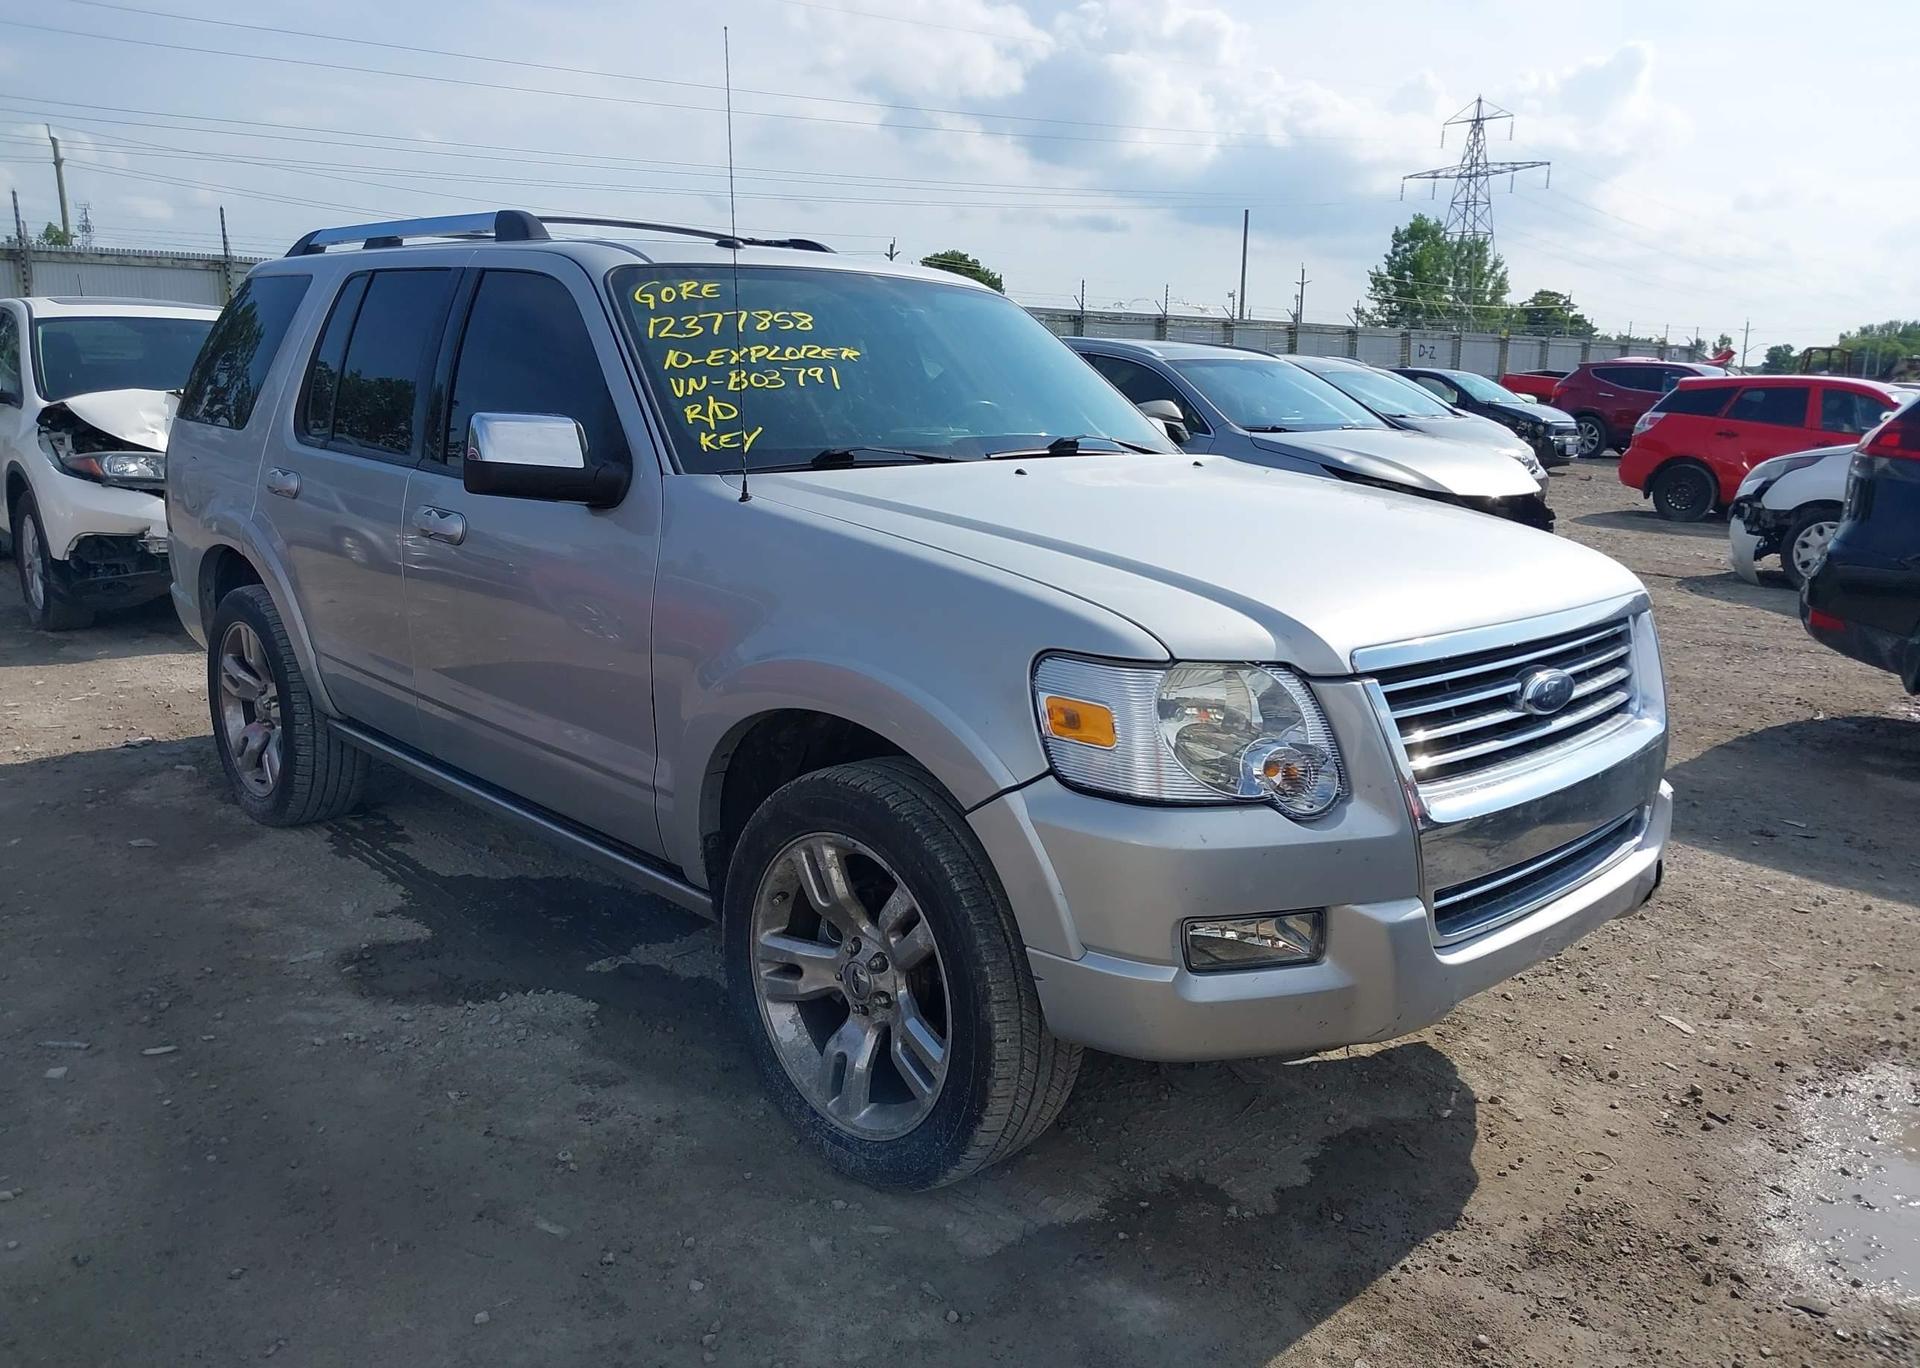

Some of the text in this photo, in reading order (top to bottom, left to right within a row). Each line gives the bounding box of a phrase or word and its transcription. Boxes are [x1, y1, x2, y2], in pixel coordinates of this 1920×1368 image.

[635, 281, 720, 309] GORE
[648, 310, 814, 339] 12377858
[684, 396, 738, 430] R/D
[701, 426, 763, 453] KEY
